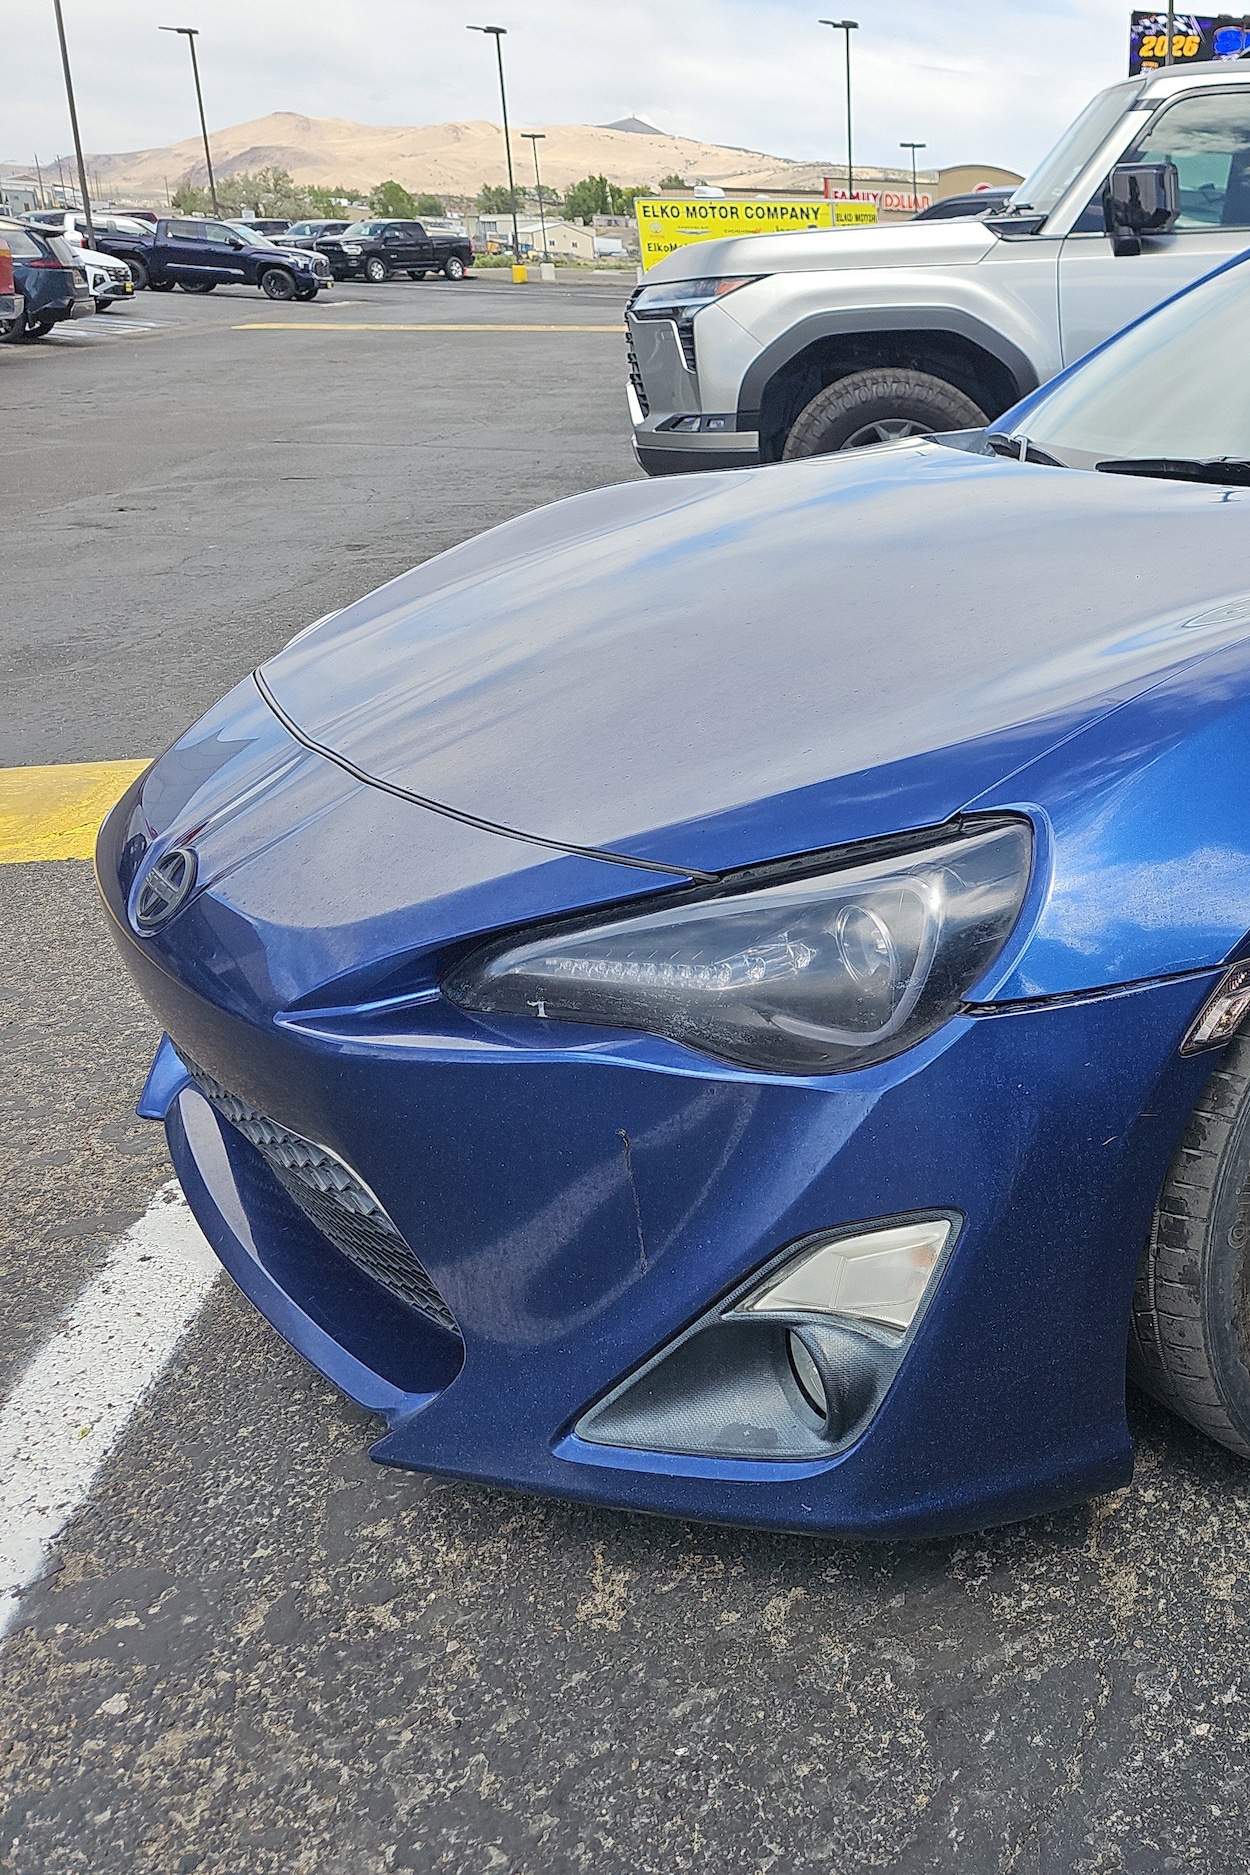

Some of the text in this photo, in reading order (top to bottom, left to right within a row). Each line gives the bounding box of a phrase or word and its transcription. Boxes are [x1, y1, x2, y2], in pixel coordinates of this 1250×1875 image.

[1139, 34, 1200, 58] 2026
[642, 205, 820, 221] ELKO MOTOR COMPANY
